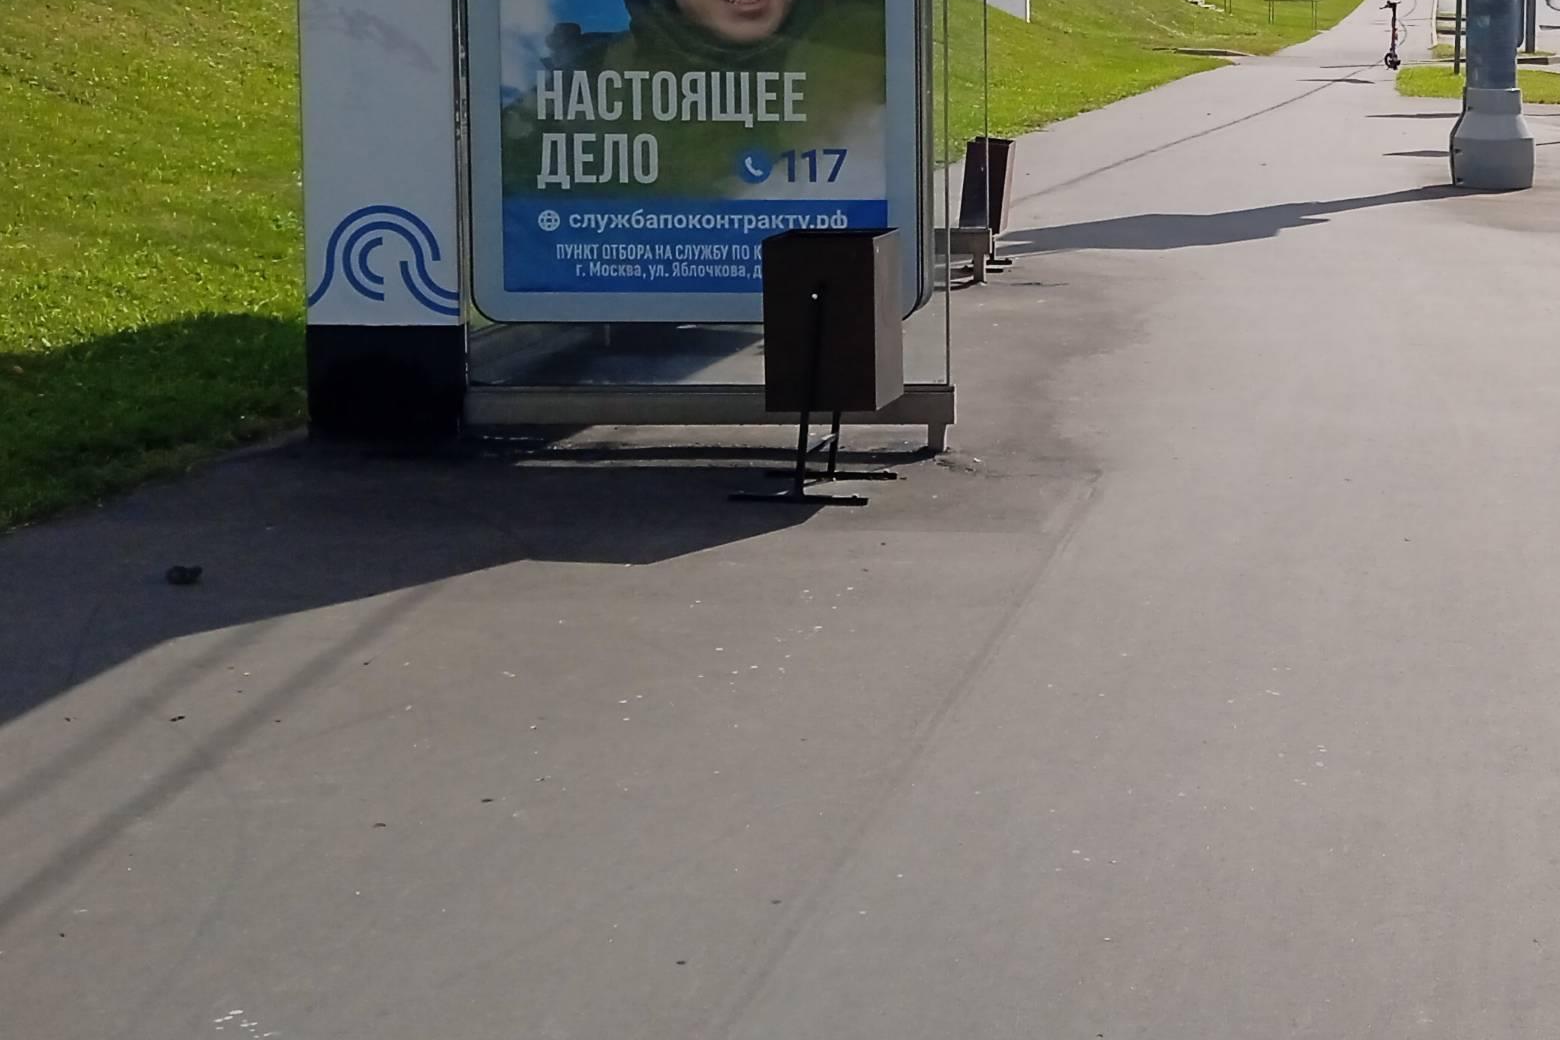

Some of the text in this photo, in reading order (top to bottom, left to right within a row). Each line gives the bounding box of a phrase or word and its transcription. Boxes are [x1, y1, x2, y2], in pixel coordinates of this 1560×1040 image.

[537, 70, 807, 128] НАСТОЯЩЕЕ
[537, 133, 659, 190] ДЕЛО
[781, 148, 848, 183] 117
[569, 209, 848, 234] службапоконтракту.рф
[556, 244, 599, 260] ПУНКТ
[602, 244, 653, 260] ОТБОРА
[655, 245, 673, 260] НА
[675, 244, 729, 260] СЛУЖБУ
[732, 245, 750, 260] ПО
[576, 264, 586, 277] г.
[589, 261, 647, 279] Москва,
[648, 264, 669, 280] ул.
[672, 262, 750, 279] Яблочкова,
